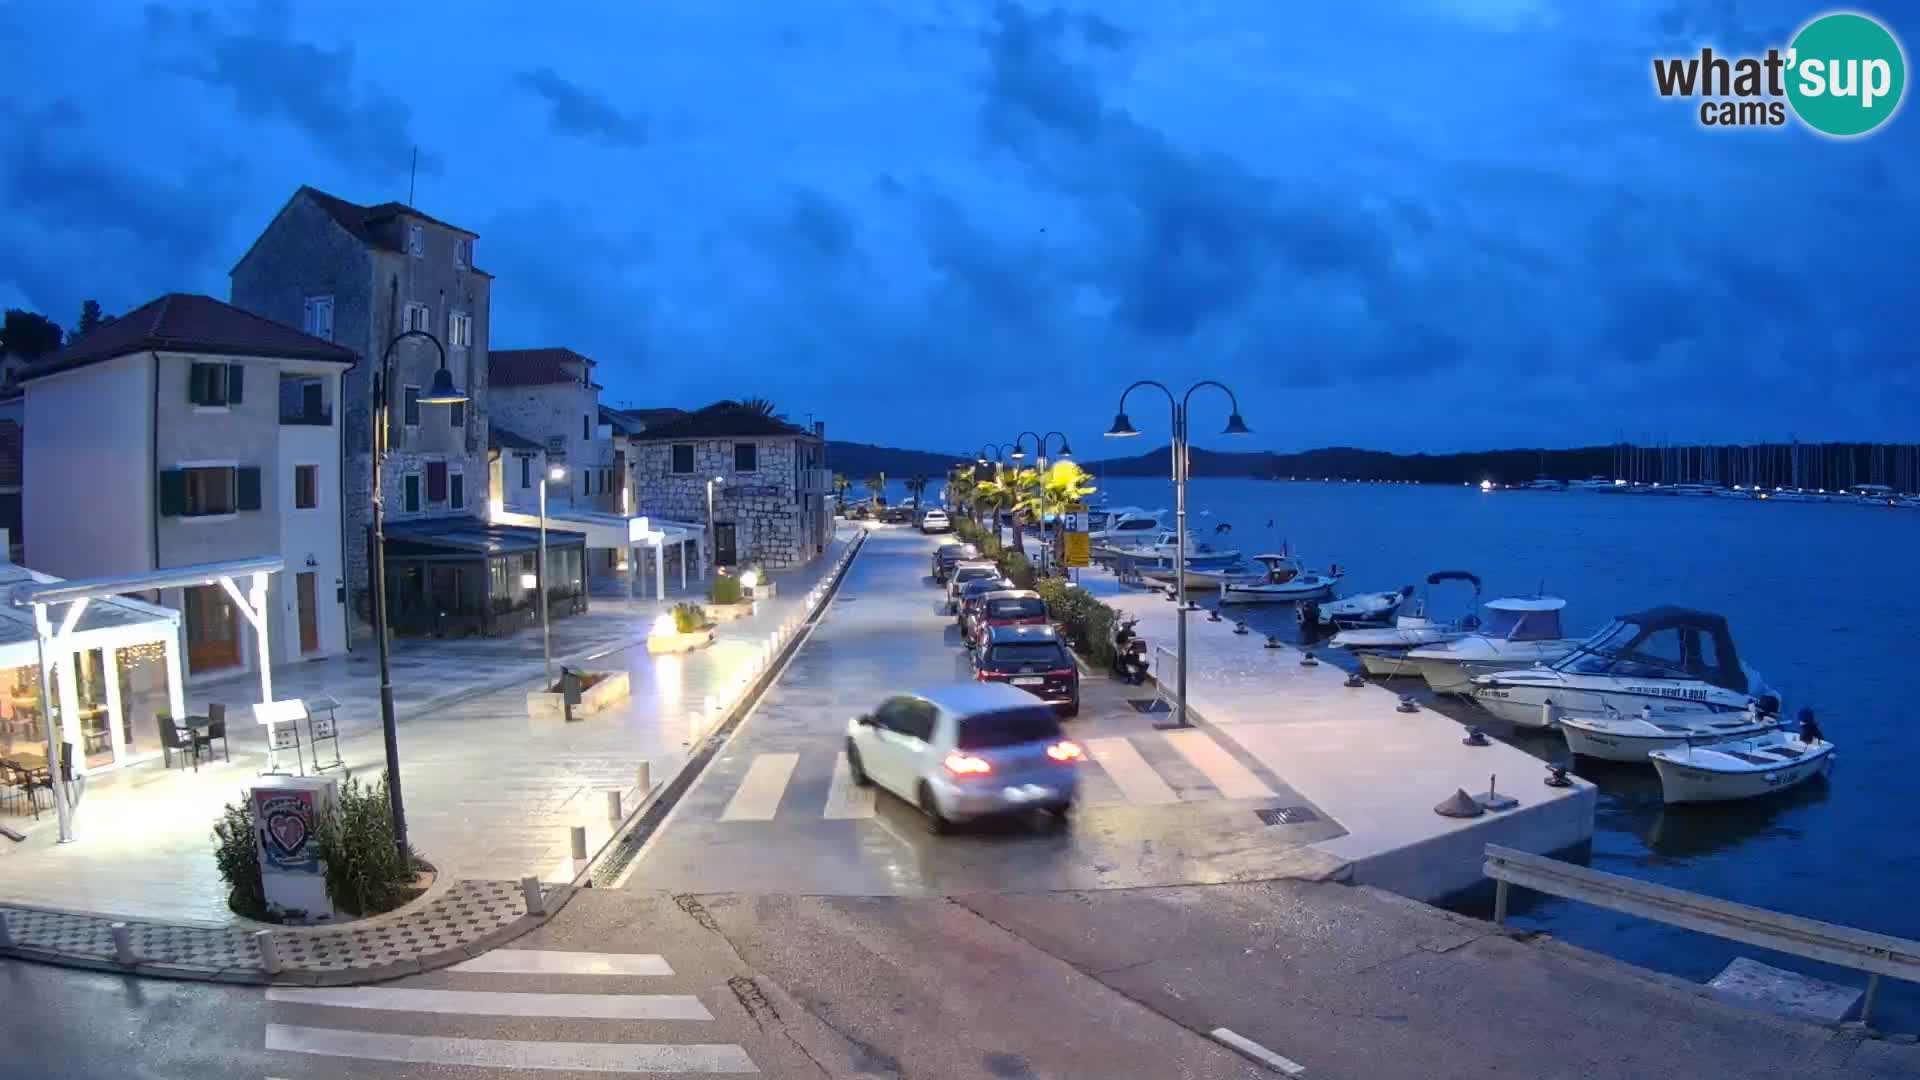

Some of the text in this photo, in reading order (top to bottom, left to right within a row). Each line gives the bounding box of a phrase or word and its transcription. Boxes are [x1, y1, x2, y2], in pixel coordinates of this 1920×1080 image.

[1661, 687, 1681, 697] RENT
[1682, 688, 1688, 698] A
[1689, 689, 1707, 700] BOAT
